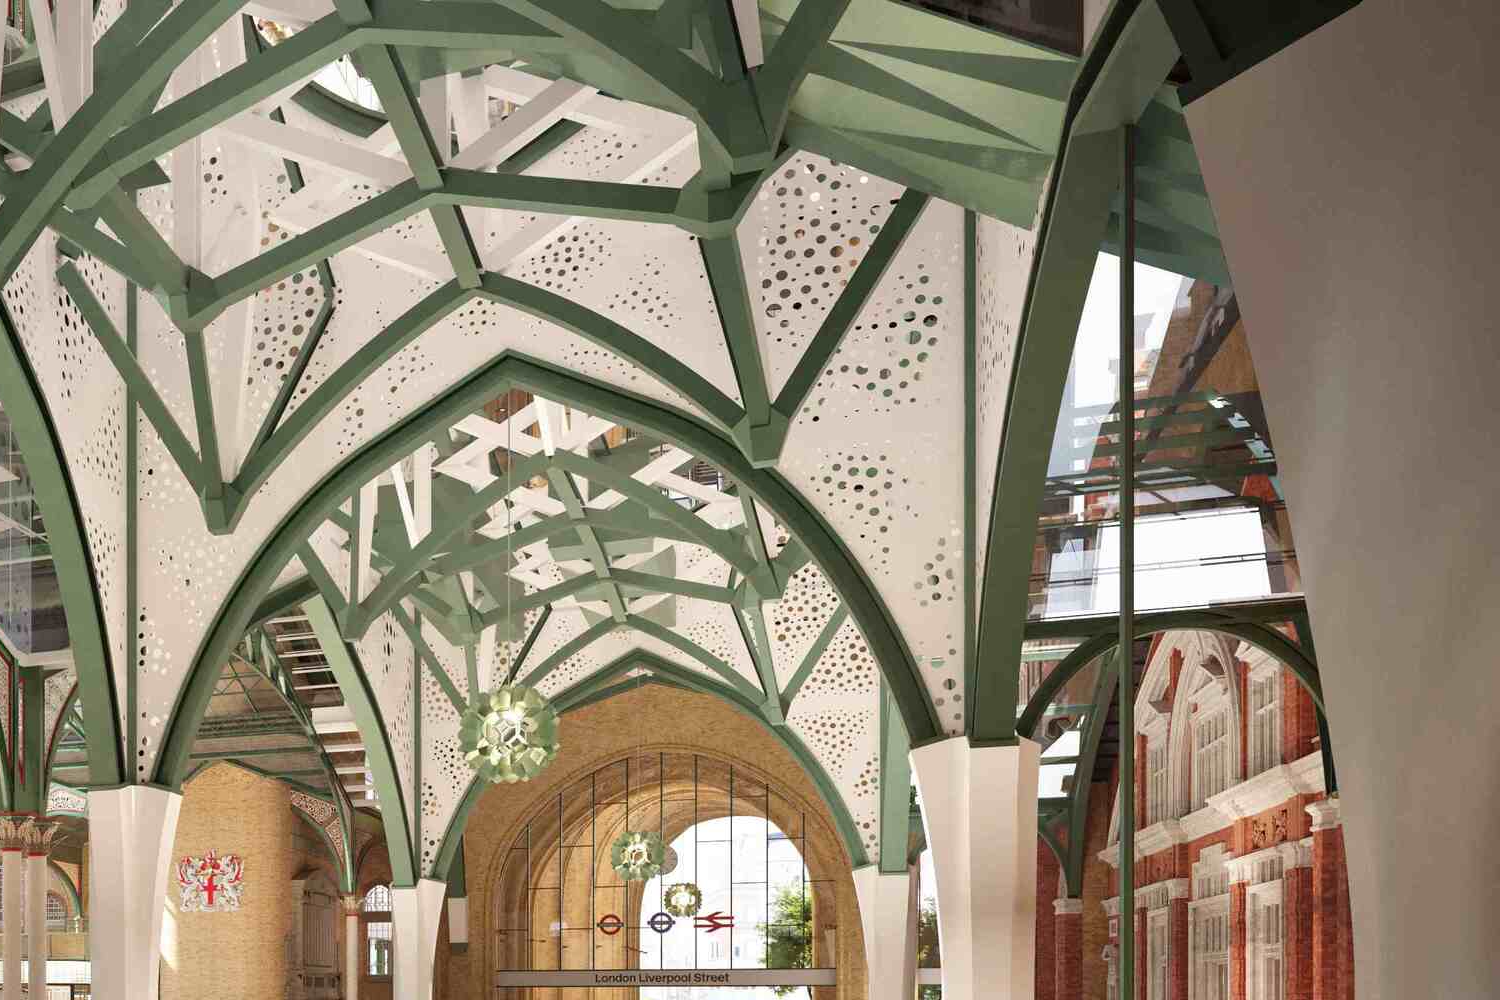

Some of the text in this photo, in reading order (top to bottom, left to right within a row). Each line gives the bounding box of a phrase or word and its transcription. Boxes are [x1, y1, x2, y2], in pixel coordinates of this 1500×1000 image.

[595, 973, 729, 984] London Liverpool Street
